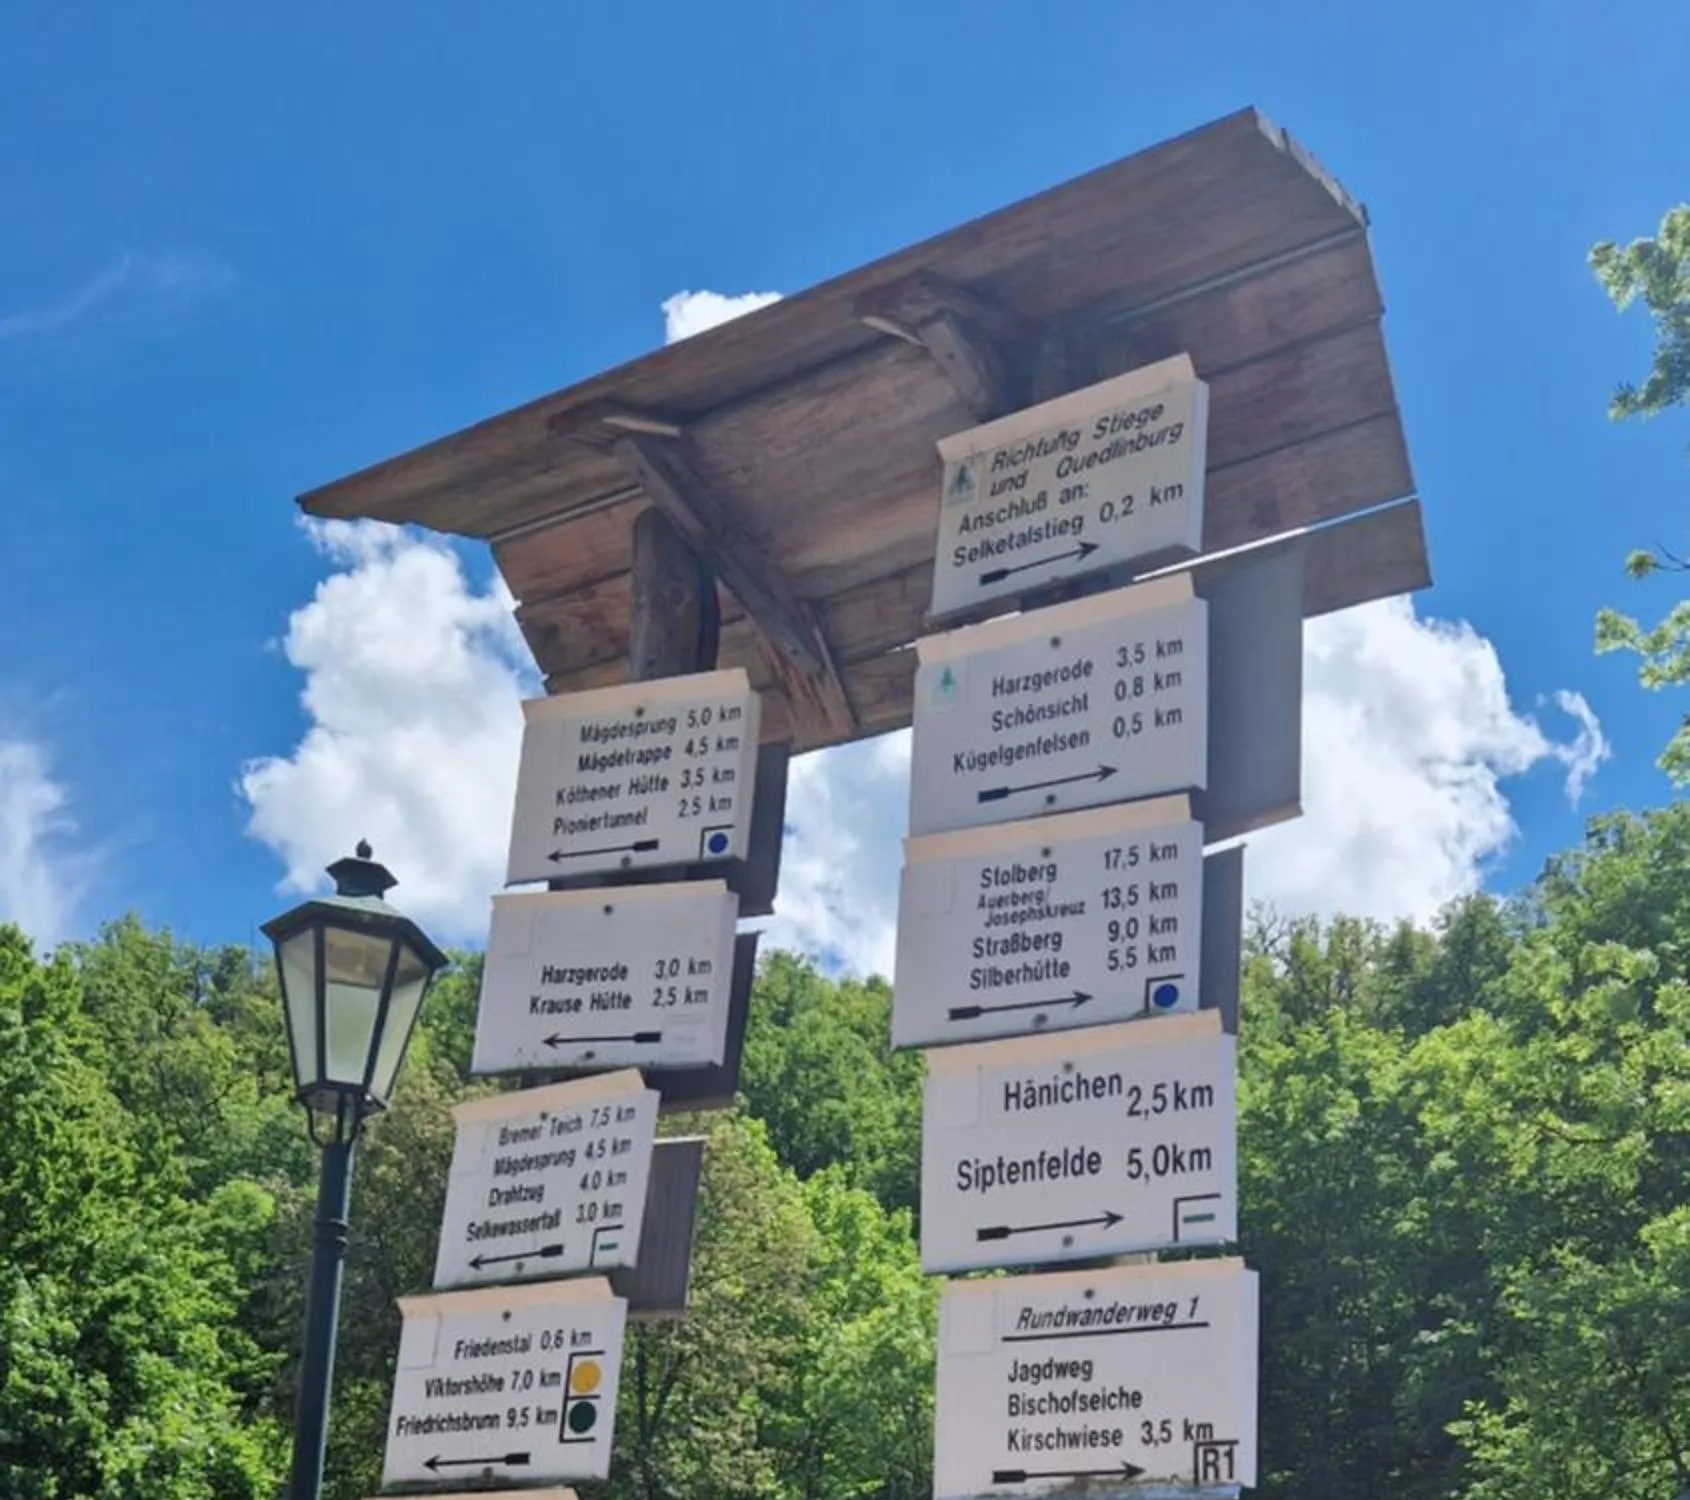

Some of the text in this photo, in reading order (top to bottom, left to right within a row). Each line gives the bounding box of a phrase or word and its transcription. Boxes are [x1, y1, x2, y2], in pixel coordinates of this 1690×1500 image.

[990, 403, 1165, 473] Richtung Stiege
[990, 422, 1184, 497] und Quedlinburg
[953, 484, 1182, 567] Selketalstieg 0,2 km
[959, 483, 1089, 535] Anschluß an:
[992, 638, 1183, 698] Harzgerode 3,5 km
[992, 693, 1089, 732] Schönsicht
[1154, 671, 1181, 691] km
[580, 706, 741, 744] Mägdesprung 5,0 km
[953, 708, 1182, 773] Kügelgenfelsen 0,5 km
[685, 737, 708, 757] 4,5
[716, 735, 739, 750] km
[556, 767, 735, 806] Köthener Hütte 3,5 km
[553, 808, 648, 836] Pioniertunnel
[709, 796, 732, 812] km
[980, 842, 1177, 888] Stolberg 17,5 km
[984, 882, 1177, 928] Josephskreuz 13,5 km
[973, 915, 1177, 958] Straßberg 9,0 km
[541, 957, 711, 986] Harzgerode 3,0 km
[970, 944, 1176, 990] Silberhütte 5,5 km
[530, 987, 707, 1014] Krause Hütte 2,5 km
[1004, 1073, 1122, 1111] Hänichen
[499, 1105, 635, 1146] Bremer Teich 7,5 km
[493, 1149, 576, 1177] Mägdesprung
[612, 1137, 631, 1154] km
[957, 1147, 1101, 1193] Siptenfelde
[488, 1185, 545, 1207] Drahtzug
[607, 1170, 627, 1186] km
[467, 1209, 561, 1242] Selkewasserfall
[603, 1201, 623, 1218] km
[1016, 1296, 1199, 1331] Rundwanderweg 1
[454, 1328, 592, 1360] Friedenstal 0,6 km
[425, 1368, 561, 1399] Viktorshöhe 7,0 km
[1008, 1359, 1092, 1385] Jagdweg
[1008, 1386, 1142, 1416] Bischofseiche
[396, 1407, 557, 1436] Friedrichsbrunn 9,5 km
[1008, 1419, 1213, 1451] Kirschwiese 3,5 km
[1202, 1447, 1234, 1481] R1
